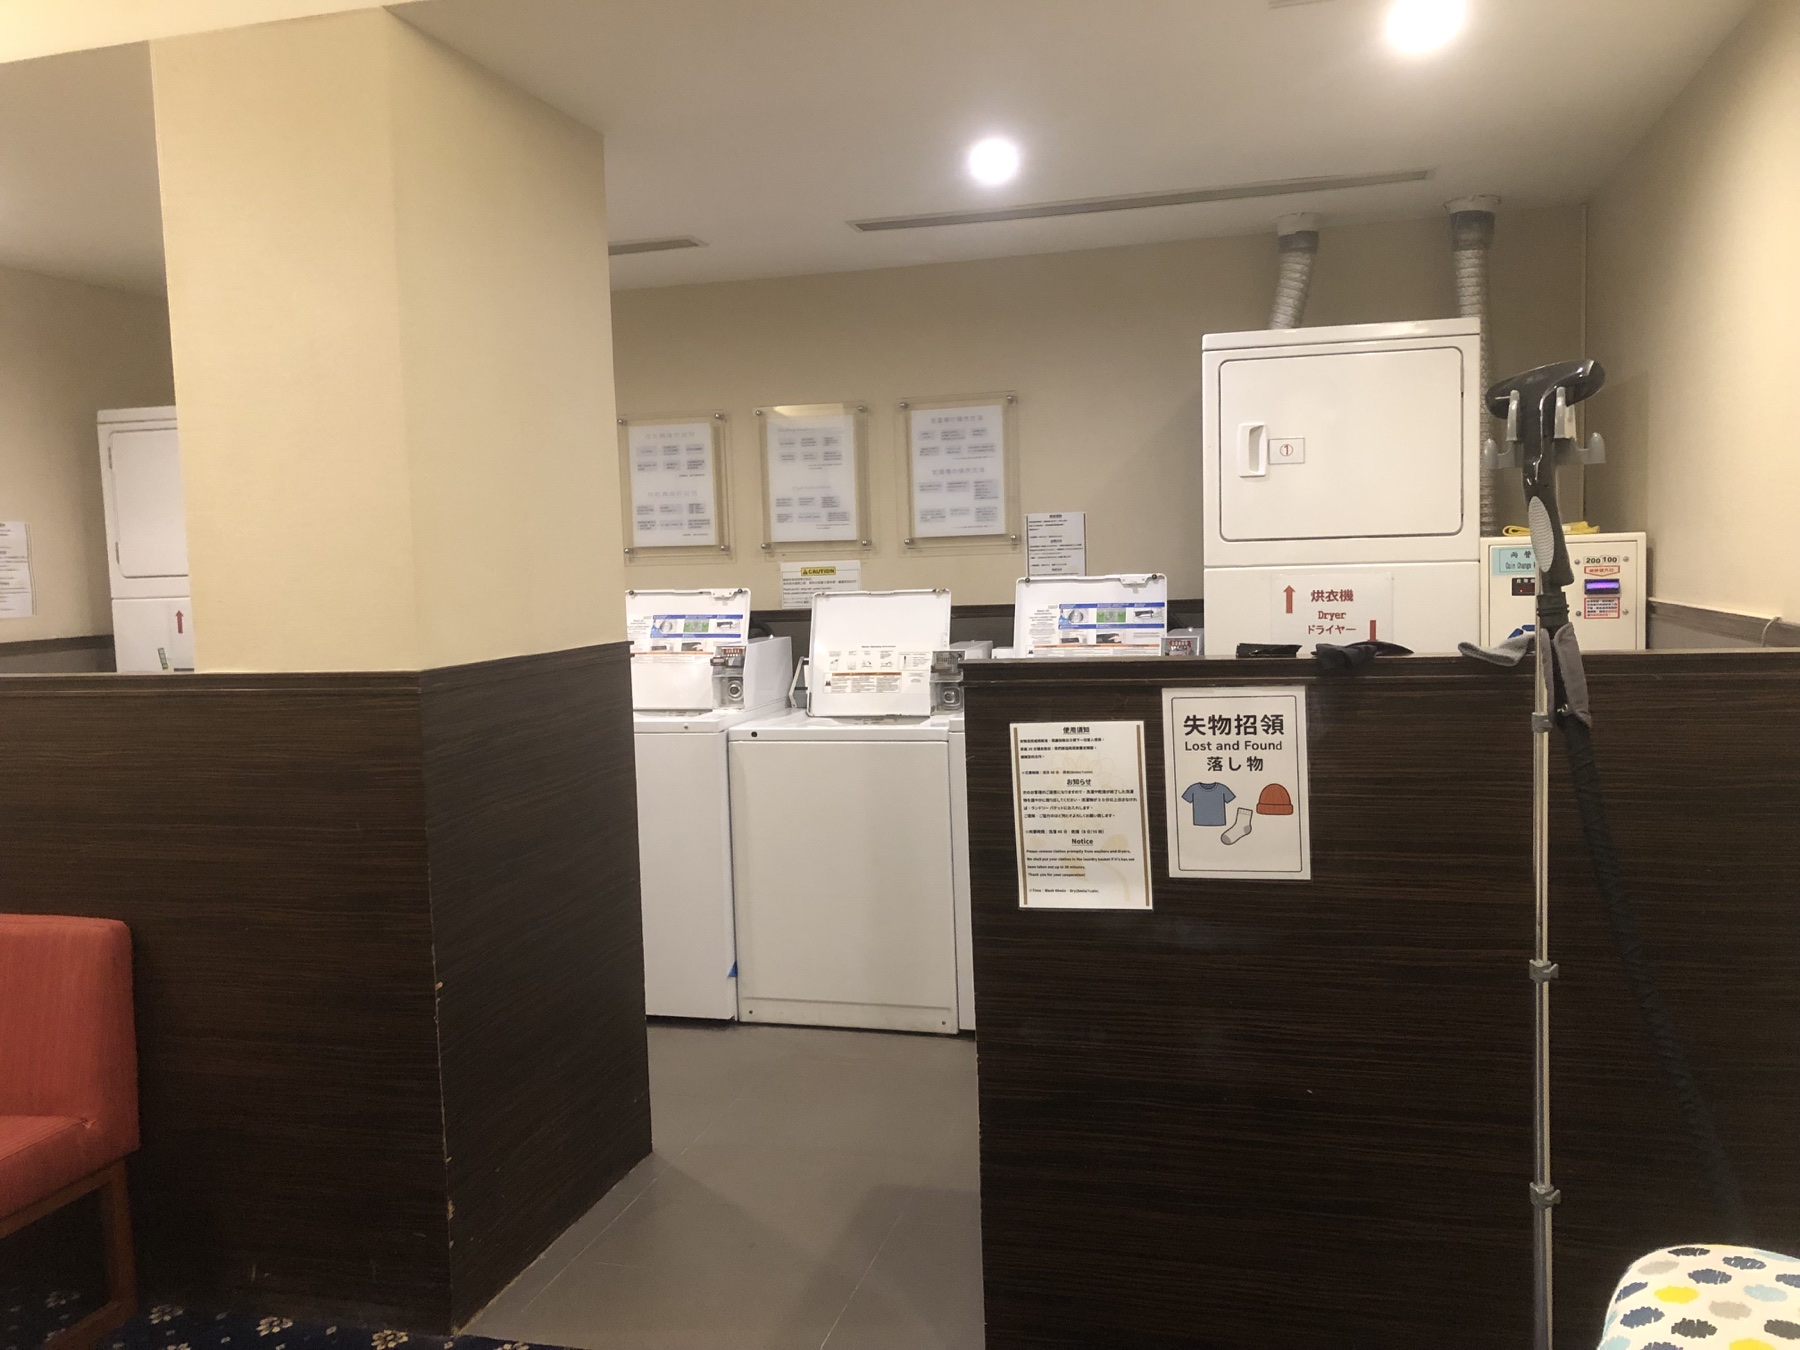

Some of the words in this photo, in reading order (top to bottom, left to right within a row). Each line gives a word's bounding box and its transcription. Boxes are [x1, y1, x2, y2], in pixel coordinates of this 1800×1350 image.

[1311, 589, 1354, 602] 烘衣機
[1318, 610, 1347, 621] Dryer
[1308, 625, 1356, 635] ドライヤー
[1183, 713, 1284, 736] 失物招領
[1185, 741, 1212, 751] Lost
[1216, 740, 1240, 750] and
[1245, 740, 1283, 750] Found
[1207, 756, 1264, 772] 落し物
